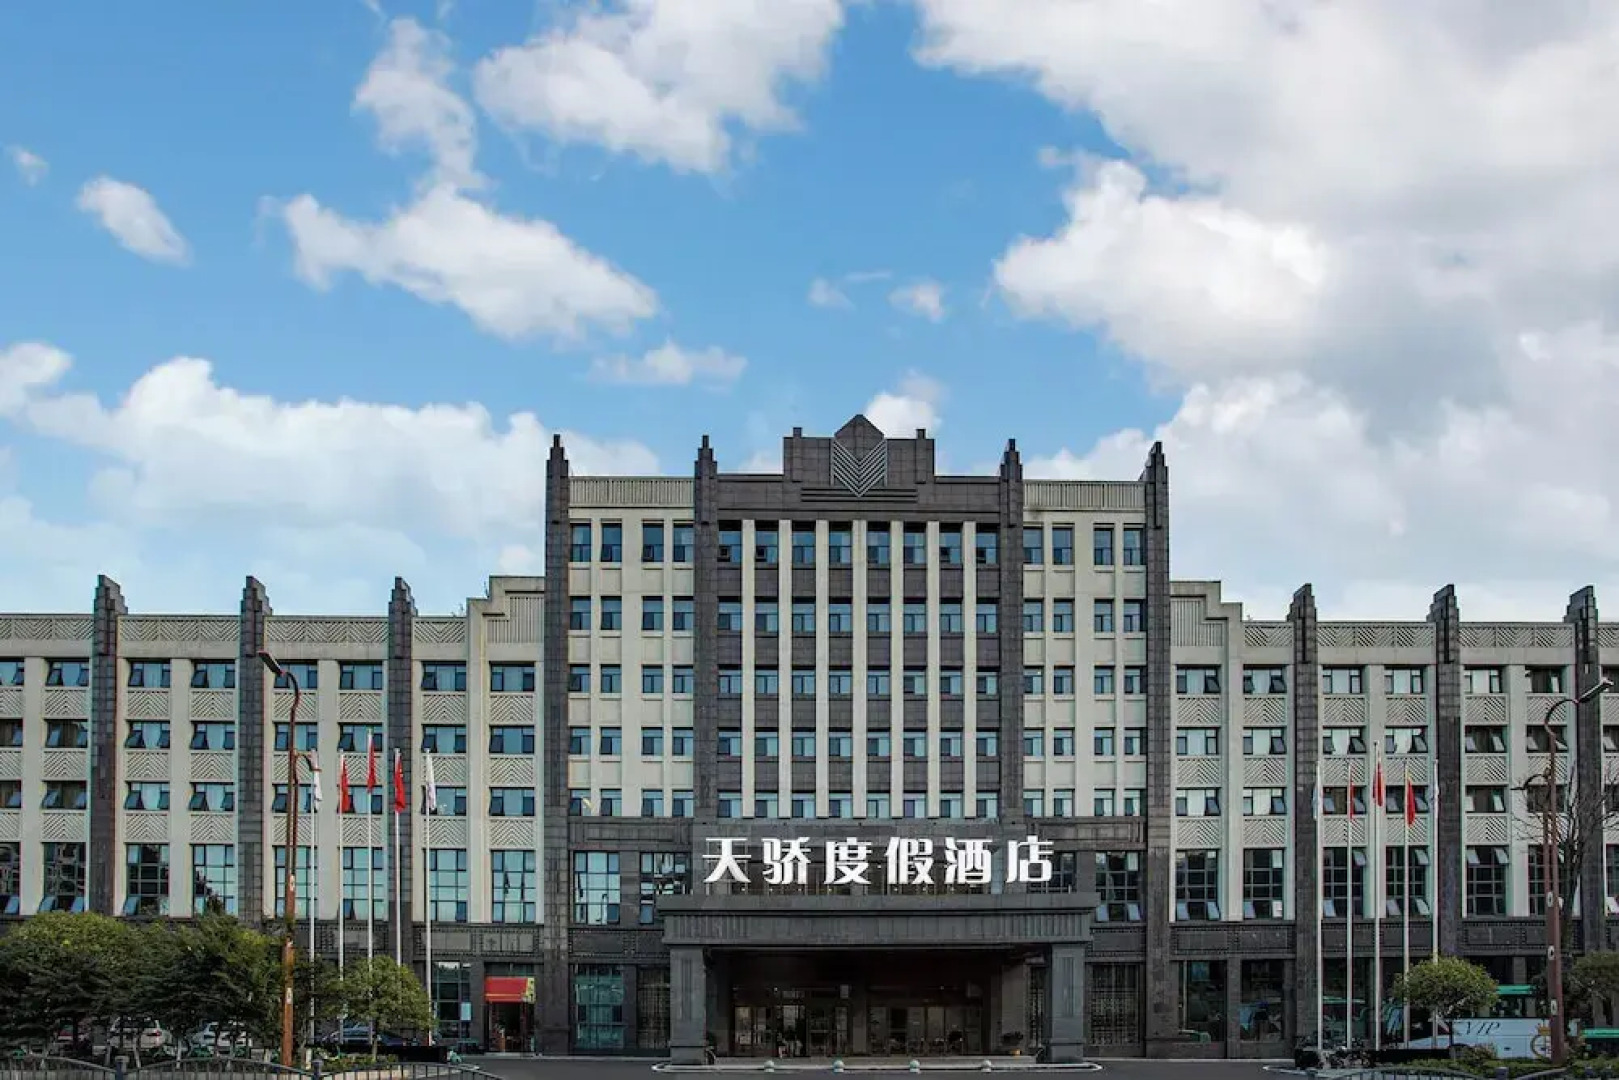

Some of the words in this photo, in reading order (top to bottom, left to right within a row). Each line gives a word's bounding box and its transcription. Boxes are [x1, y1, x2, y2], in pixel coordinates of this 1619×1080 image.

[703, 835, 1054, 885] 天骄度假酒店
